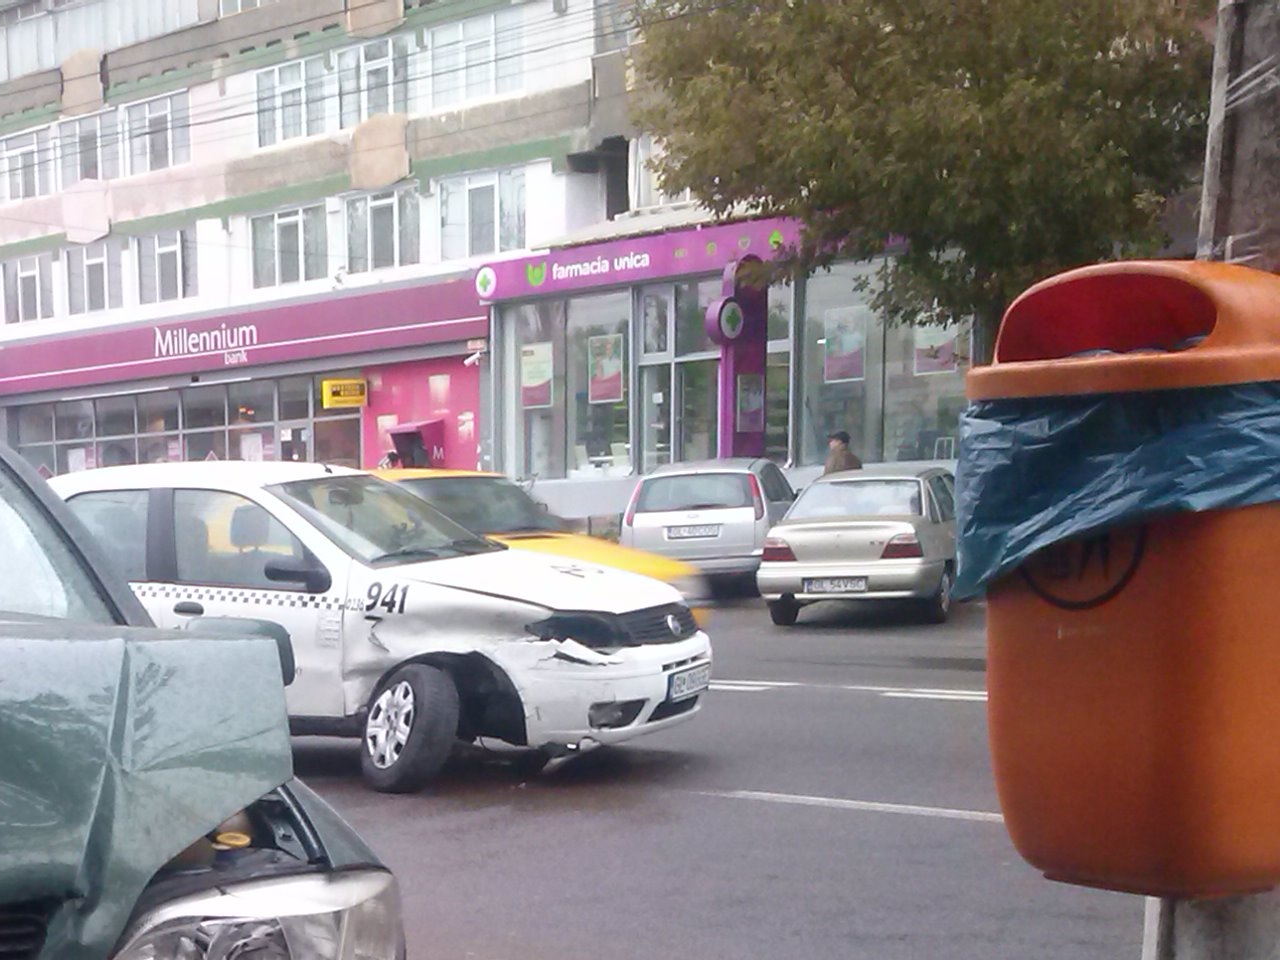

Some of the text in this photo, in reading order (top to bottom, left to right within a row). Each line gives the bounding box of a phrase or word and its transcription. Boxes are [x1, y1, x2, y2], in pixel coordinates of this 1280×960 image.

[552, 256, 609, 280] farmacia
[614, 251, 650, 271] unica
[154, 323, 257, 357] Millennium
[224, 350, 248, 365] bank
[365, 581, 410, 614] 941
